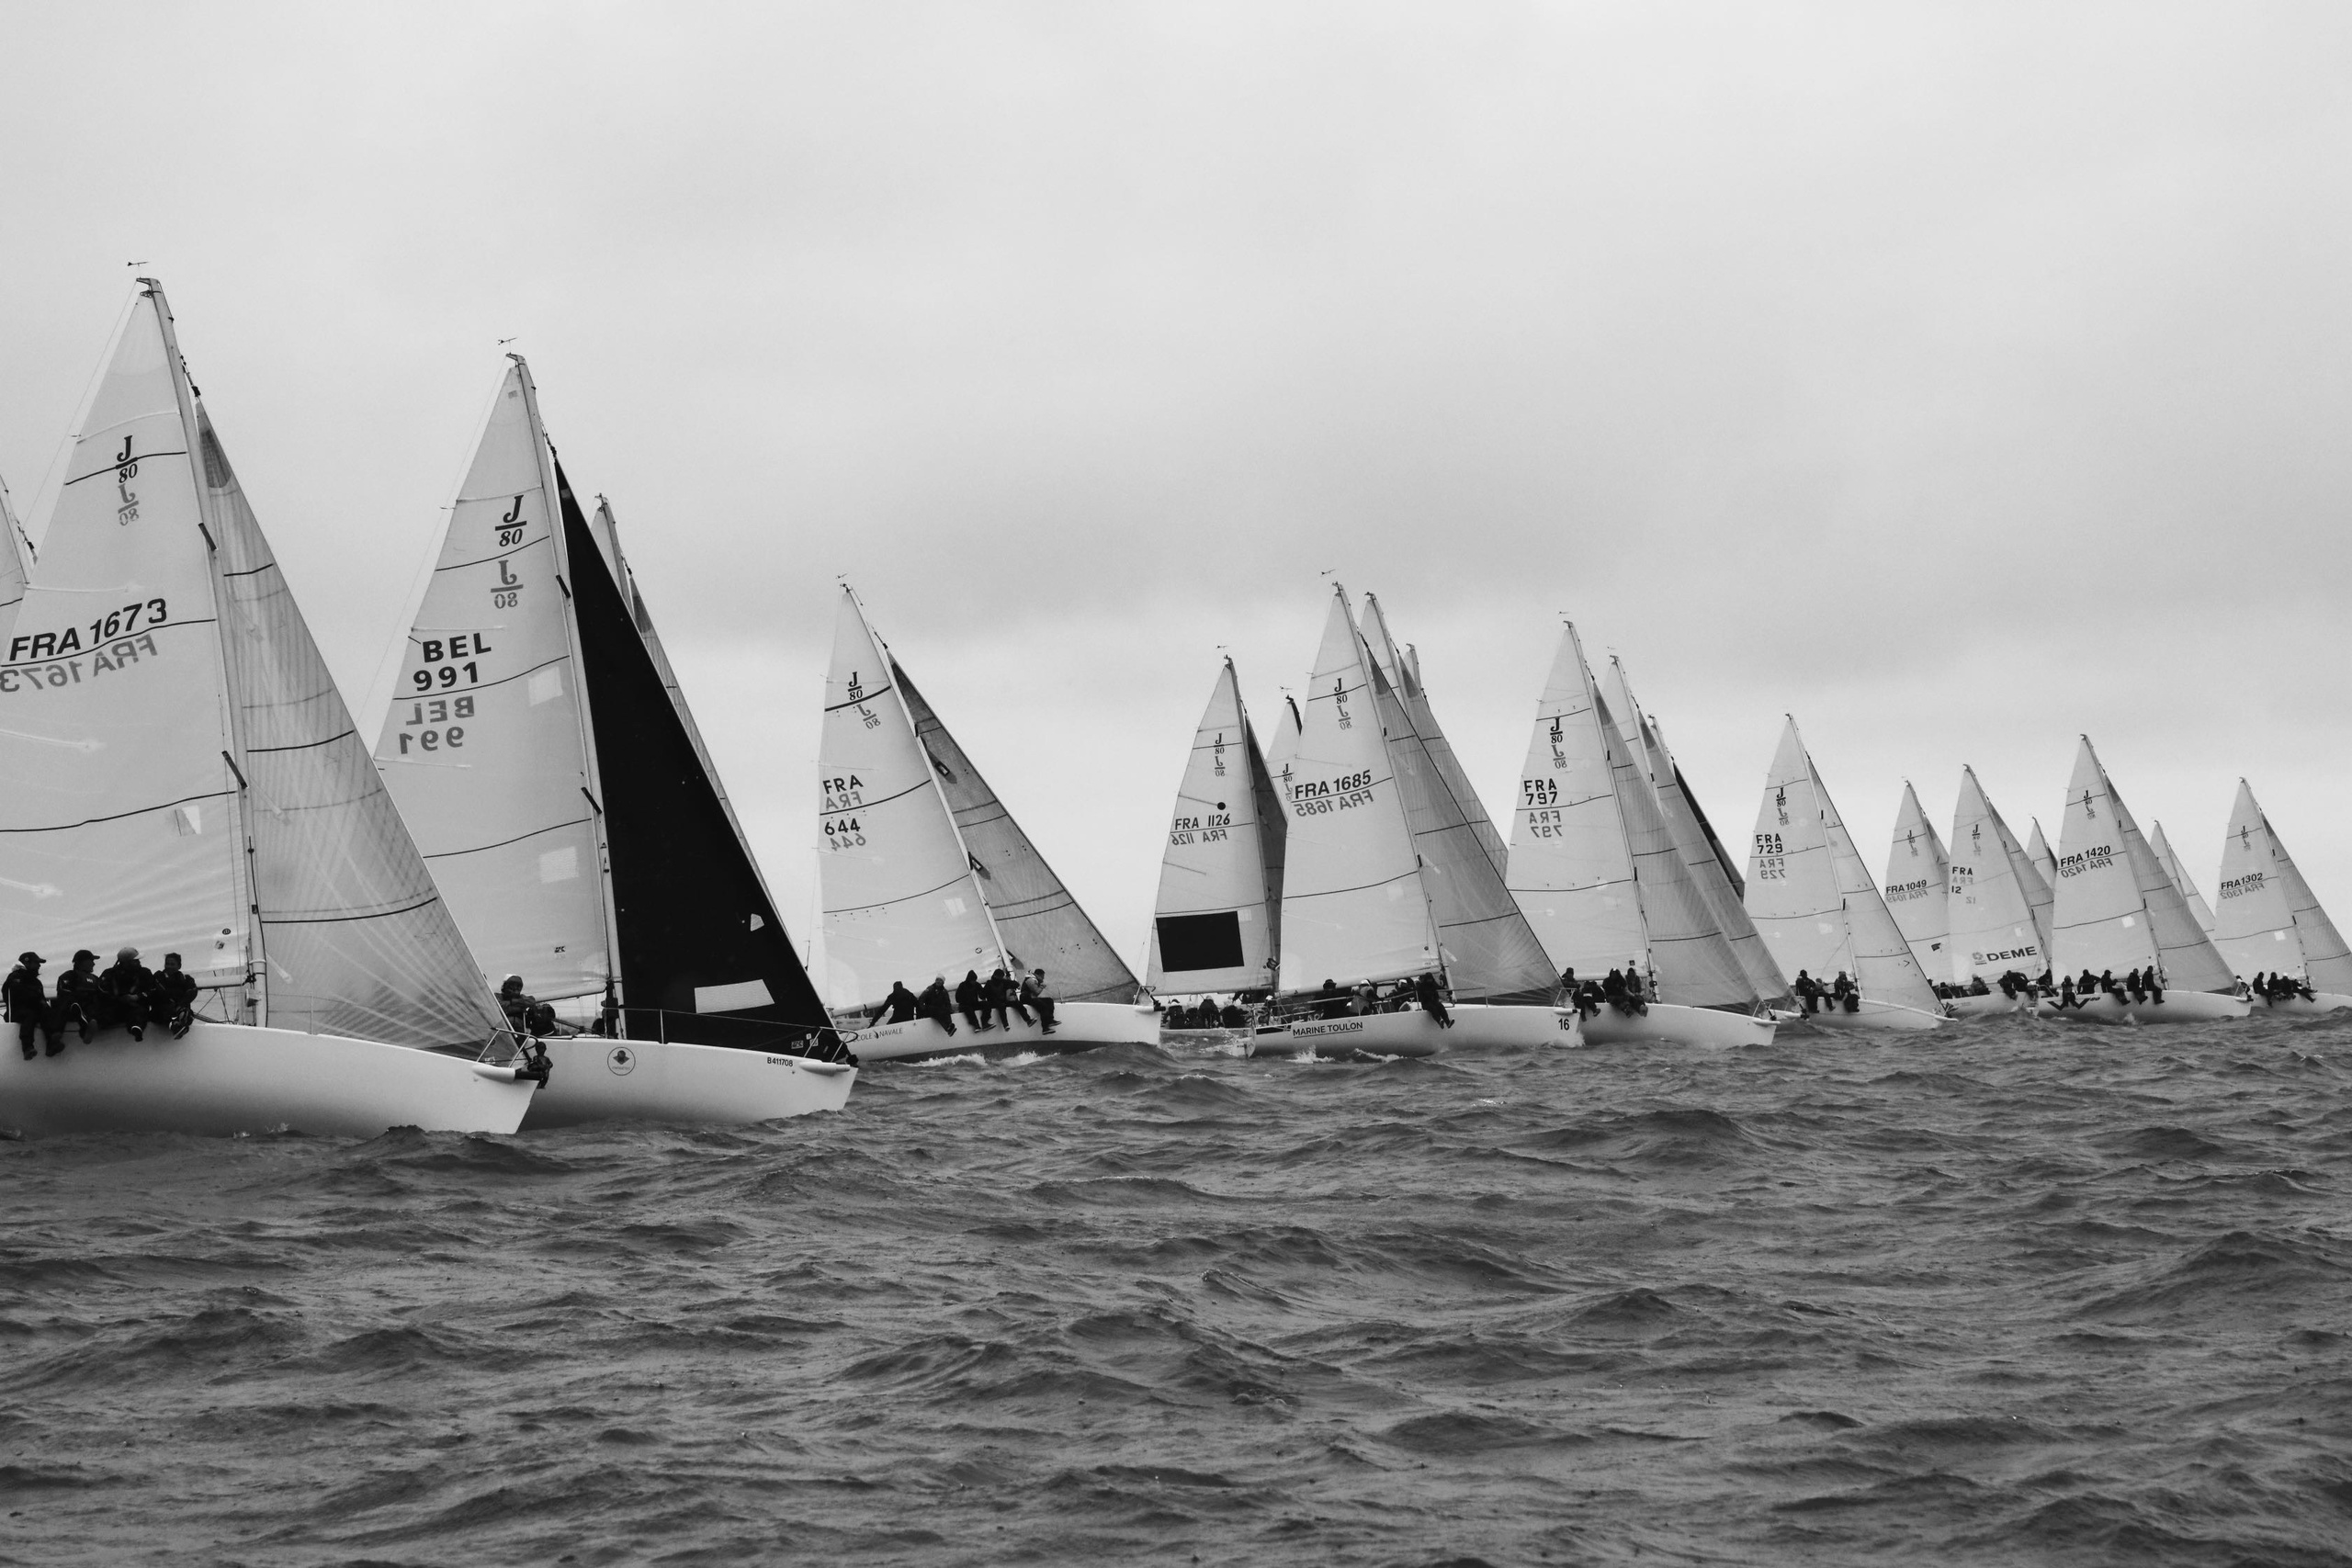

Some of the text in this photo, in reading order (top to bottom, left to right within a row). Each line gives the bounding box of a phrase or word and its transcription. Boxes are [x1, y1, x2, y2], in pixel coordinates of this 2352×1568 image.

[117, 435, 132, 461] J
[119, 463, 138, 483] 80
[503, 495, 524, 524] J
[499, 528, 523, 547] 80
[9, 598, 167, 661] FRA 1673
[423, 632, 492, 663] BEL
[413, 661, 478, 691] 991
[849, 671, 858, 687] J
[1334, 678, 1341, 693] J
[849, 689, 863, 700] 80
[1336, 694, 1347, 704] 80
[1551, 717, 1560, 731] J
[1215, 733, 1222, 744] J
[1551, 735, 1562, 744] 80
[1215, 747, 1225, 755] 80
[1283, 763, 1288, 773] J
[822, 774, 864, 794] FRA
[1295, 770, 1371, 799] FRA 1685
[1523, 779, 1556, 792] FRA
[1525, 792, 1557, 805] 797
[1777, 787, 1783, 798] J
[824, 818, 861, 836] 644
[1175, 814, 1231, 830] FRA 1126
[1973, 824, 1978, 833] J
[1757, 834, 1781, 843] FRA
[1758, 843, 1782, 854] 729
[2061, 845, 2110, 867] FRA 1420
[1951, 886, 1962, 894] 12
[1986, 946, 2038, 961] DEME
[1293, 1021, 1363, 1036] MARINE TOULON
[1558, 1018, 1569, 1031] 16
[880, 1028, 902, 1037] NAVALE
